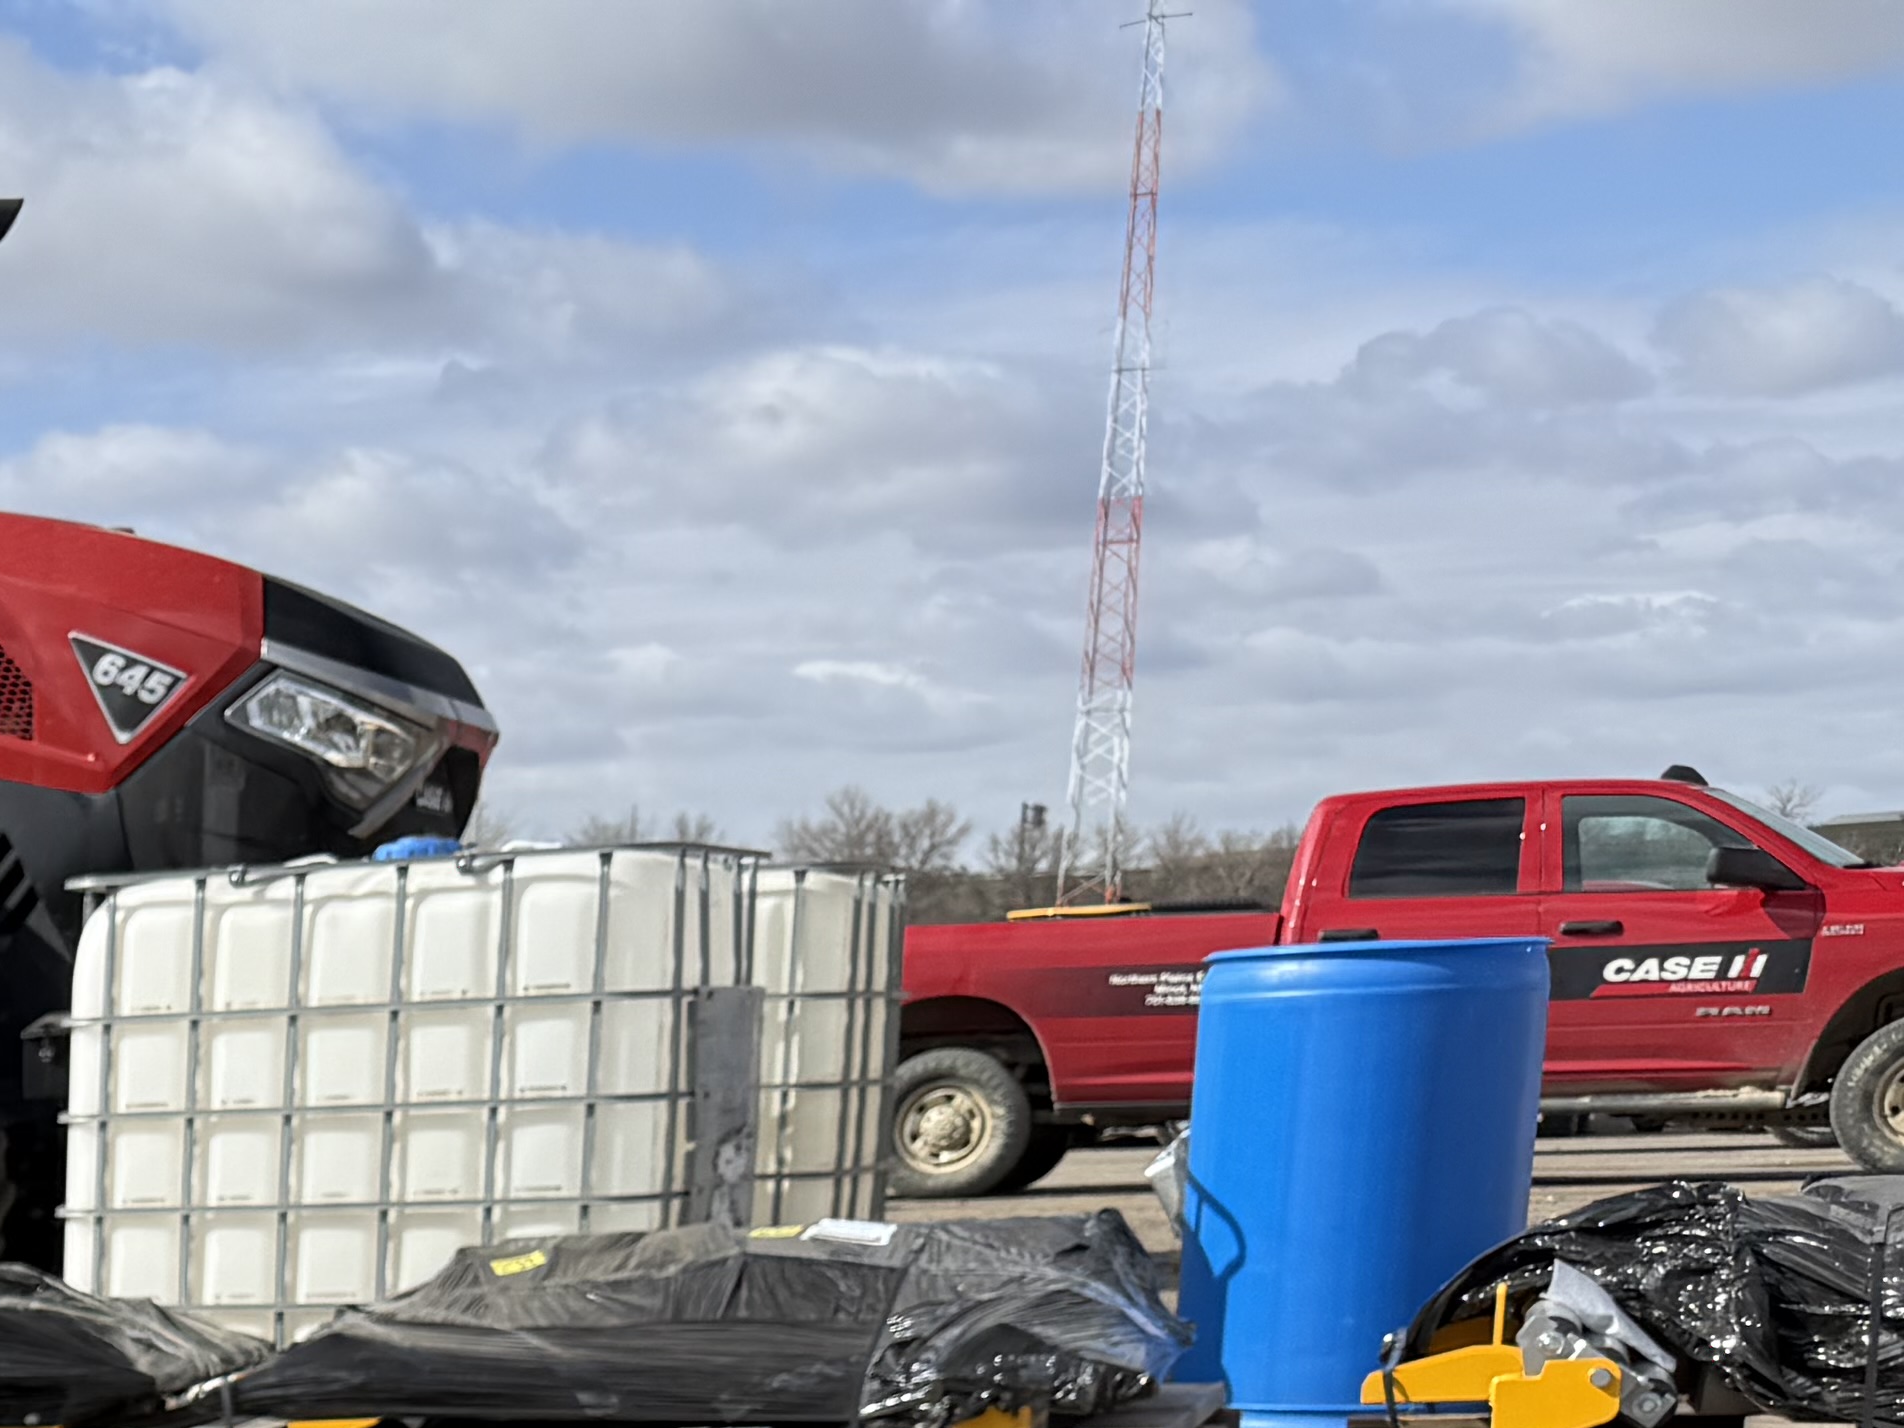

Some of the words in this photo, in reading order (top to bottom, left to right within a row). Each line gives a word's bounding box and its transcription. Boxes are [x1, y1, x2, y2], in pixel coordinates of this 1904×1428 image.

[92, 652, 175, 705] 645
[1602, 955, 1723, 982] CASE
[1668, 981, 1752, 993] AGRICULTURE
[1695, 1005, 1771, 1017] RAM
